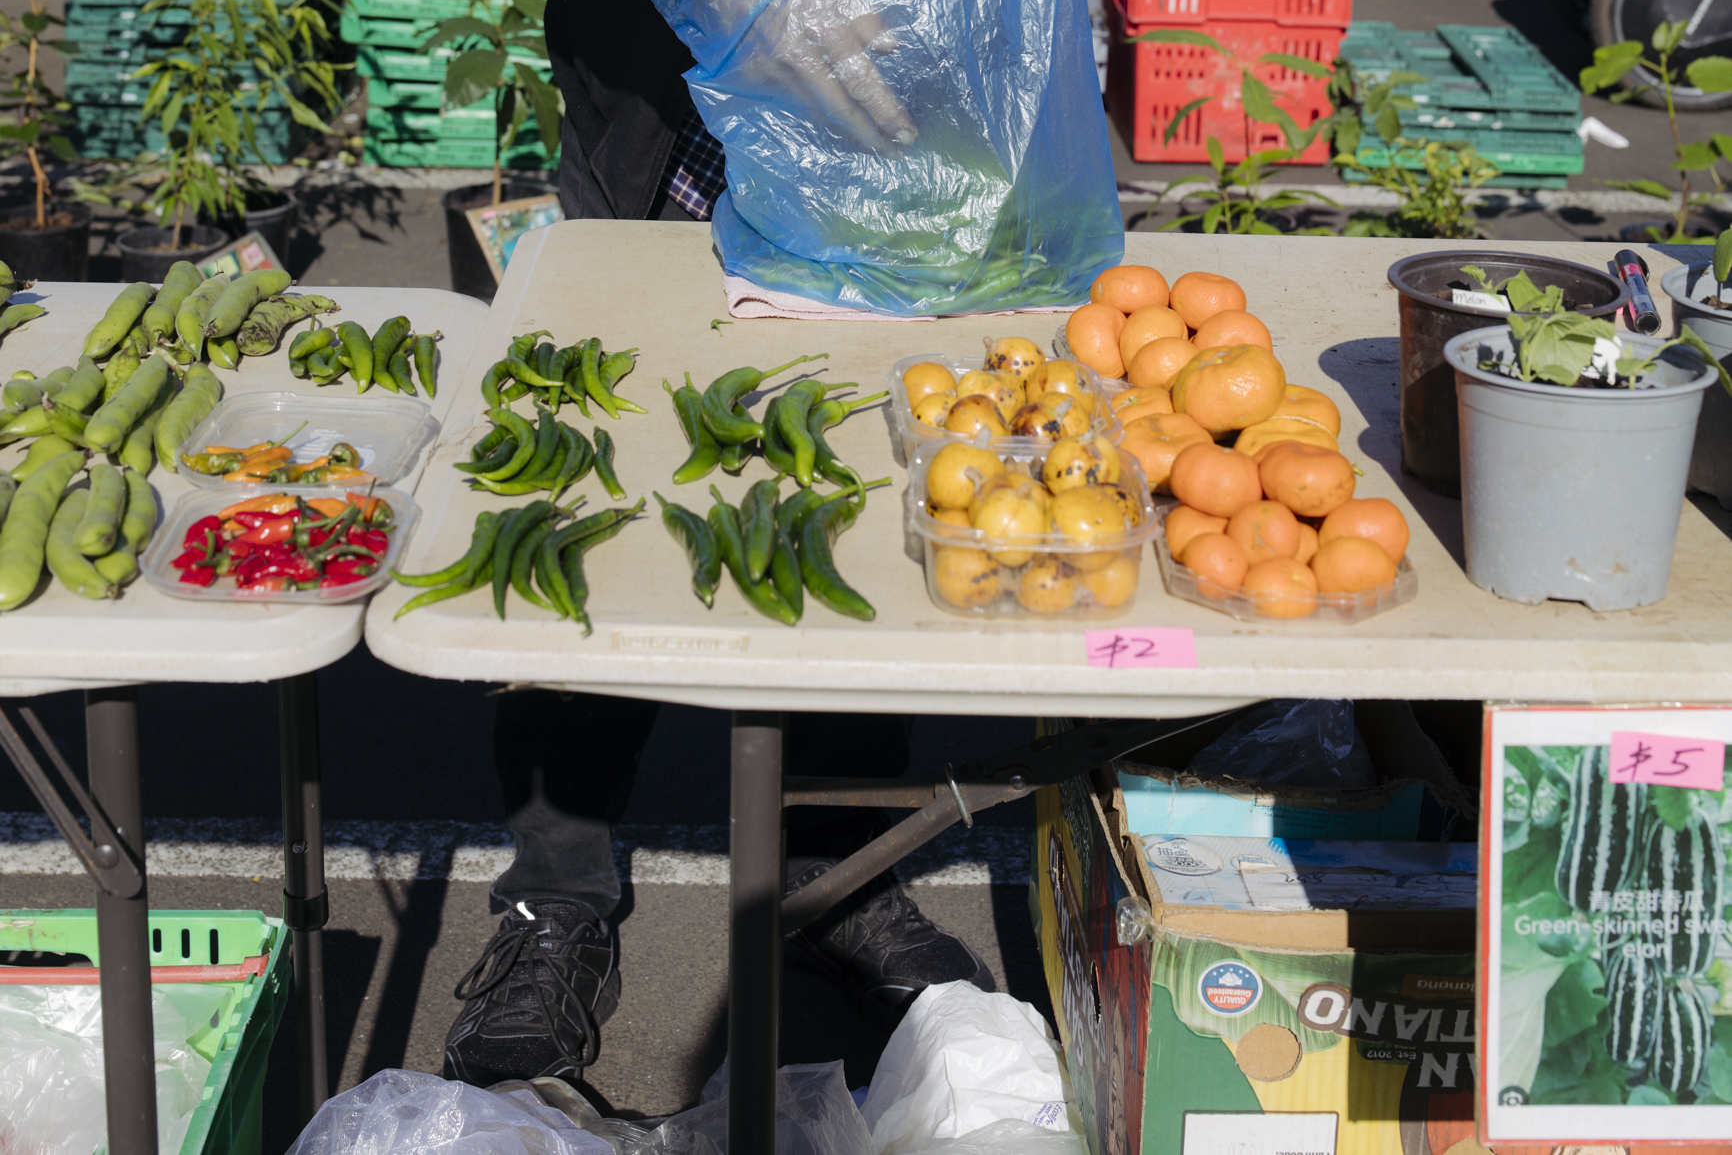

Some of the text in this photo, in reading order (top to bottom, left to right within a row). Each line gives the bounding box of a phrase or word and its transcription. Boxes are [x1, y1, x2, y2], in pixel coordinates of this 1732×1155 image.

[1088, 634, 1159, 667] $2
[1617, 741, 1704, 782] $5
[1514, 915, 1679, 936] Green-skinned
[1208, 988, 1251, 997] Guaranteed
[1213, 996, 1246, 1004] QUALITY
[1366, 1049, 1417, 1060] Est. 2012
